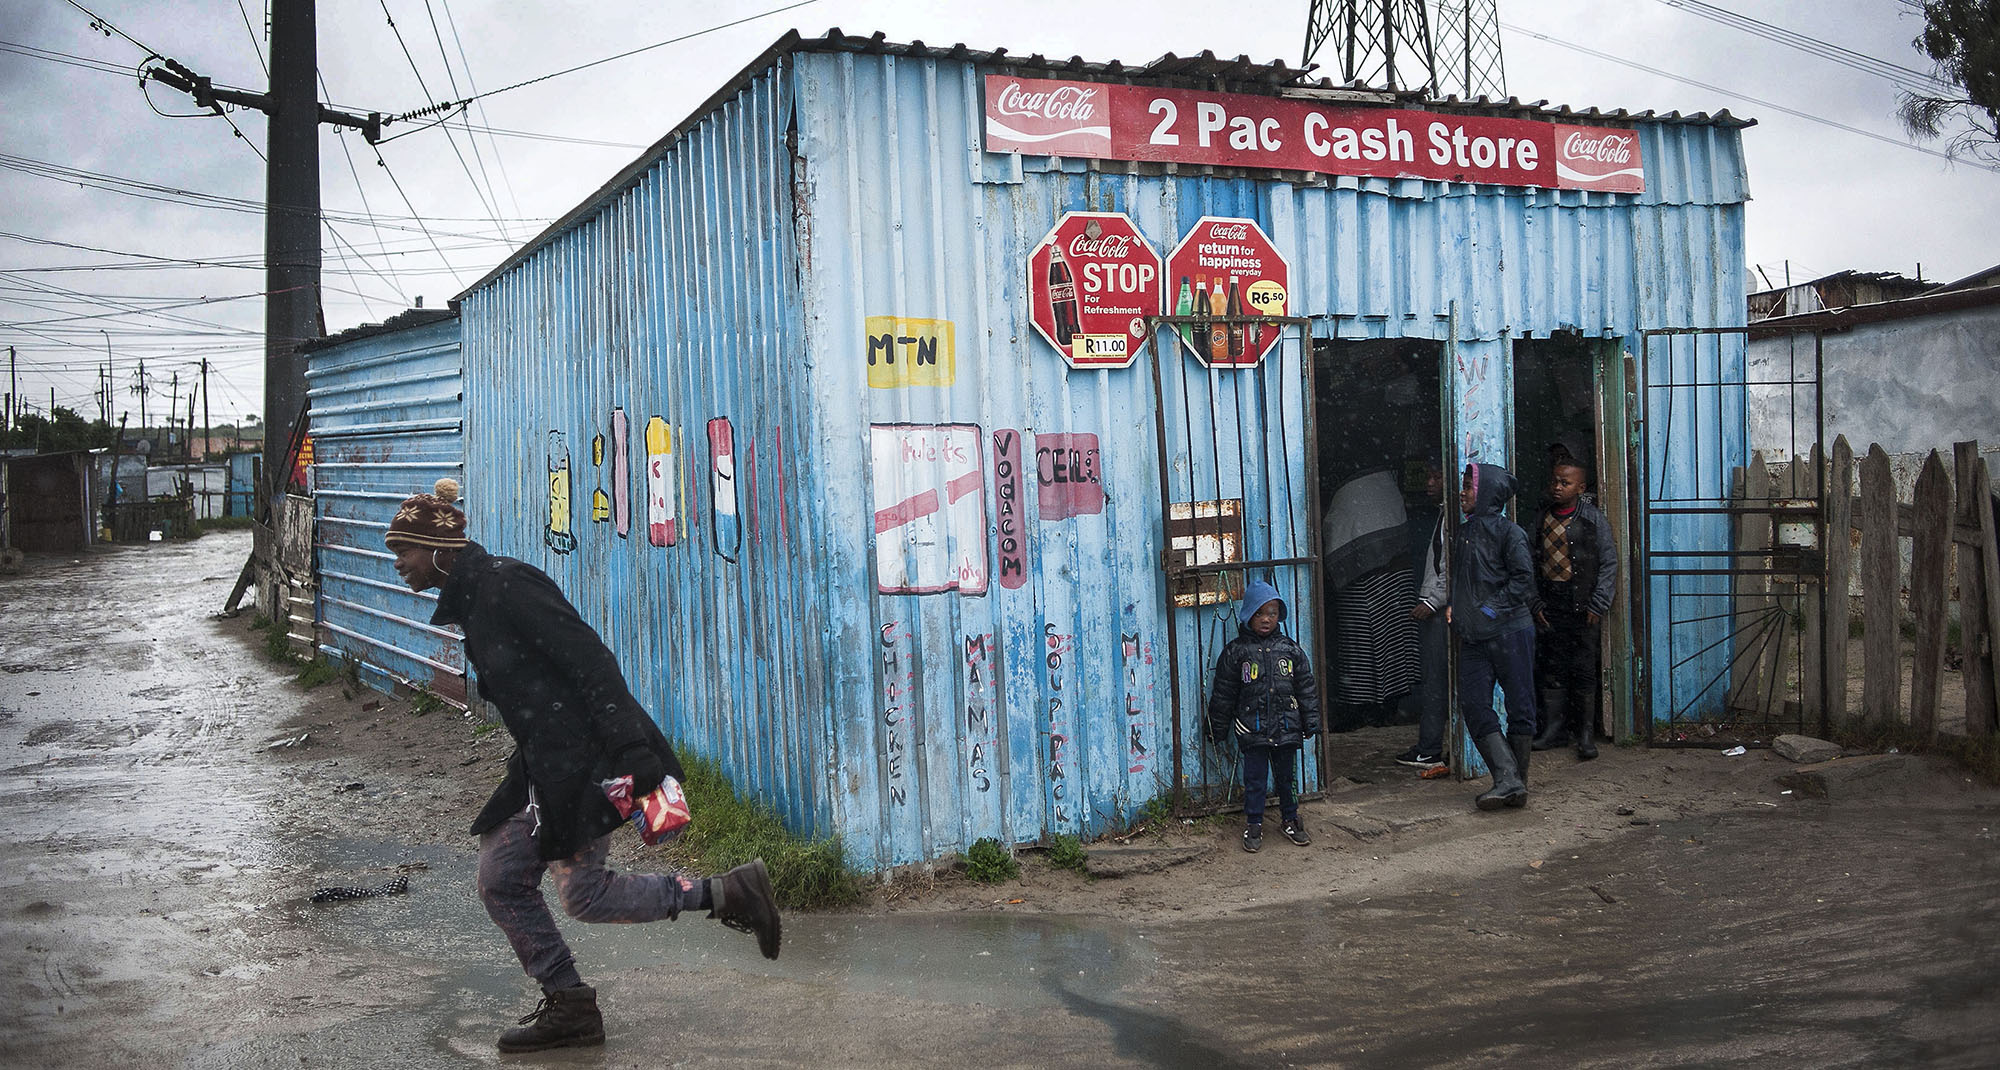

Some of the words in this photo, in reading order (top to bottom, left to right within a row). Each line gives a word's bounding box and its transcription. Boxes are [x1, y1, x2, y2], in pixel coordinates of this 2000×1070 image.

[996, 81, 1099, 121] Coca-Cola
[1148, 98, 1181, 146] 2
[1196, 102, 1282, 152] Pac
[1304, 112, 1416, 163] Cash
[1428, 121, 1539, 171] Store
[1562, 131, 1634, 164] Coca-Cola
[1069, 233, 1133, 258] Coca-Cola
[1209, 223, 1249, 240] Coca-Cola
[1198, 242, 1239, 256] return
[1240, 245, 1255, 256] for
[1199, 254, 1262, 269] happiness
[1083, 262, 1155, 294] STOP
[1230, 269, 1262, 278] everyday
[1083, 305, 1142, 315] Refreshment
[1084, 294, 1100, 303] For
[1251, 292, 1284, 305] R6.50
[1045, 622, 1063, 722] SOUP
[1122, 632, 1147, 756] MILK
[880, 621, 907, 807] CHICKEN
[965, 633, 991, 793] MAMAS
[1050, 734, 1071, 823] PACK
